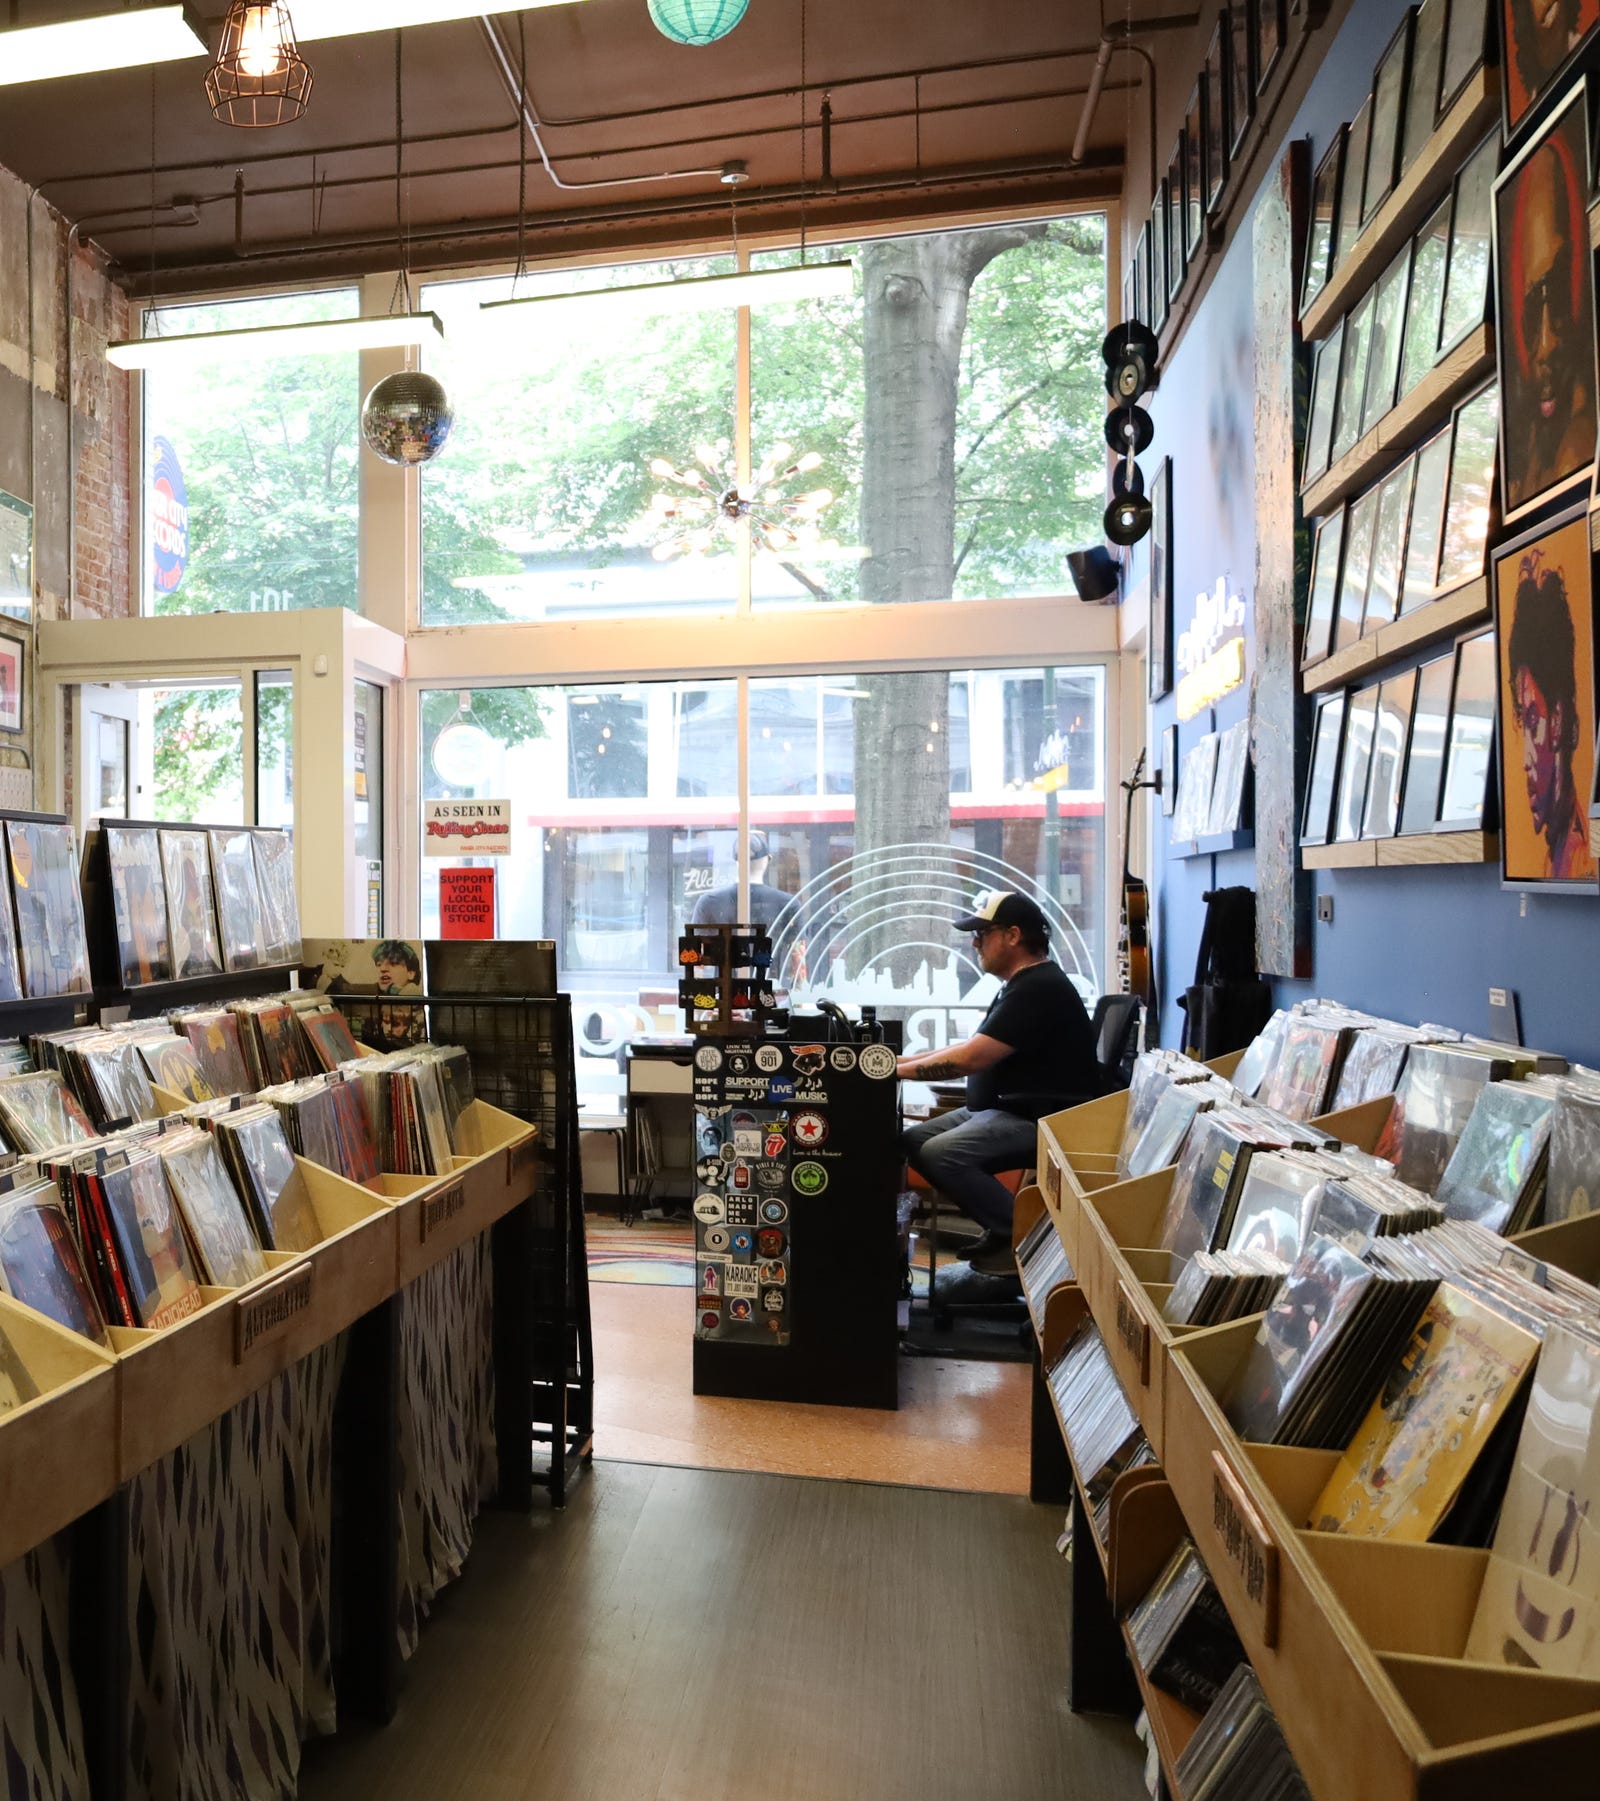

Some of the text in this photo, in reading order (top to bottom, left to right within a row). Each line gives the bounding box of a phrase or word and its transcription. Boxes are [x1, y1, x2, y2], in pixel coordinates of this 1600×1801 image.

[434, 805, 502, 817] AS SEEN IN
[440, 875, 494, 884] SUPPORT
[451, 885, 482, 894] YOUR
[448, 895, 486, 903] LOCAL
[443, 904, 490, 913] RECORD
[448, 914, 486, 923] STORE
[760, 1056, 777, 1067] 901
[724, 1077, 770, 1087] SUPPORT
[771, 1084, 793, 1094] LIVE
[795, 1091, 828, 1101] MUSIC
[726, 1265, 757, 1283] KARAOKE
[147, 1289, 202, 1329] RADIOHEAD
